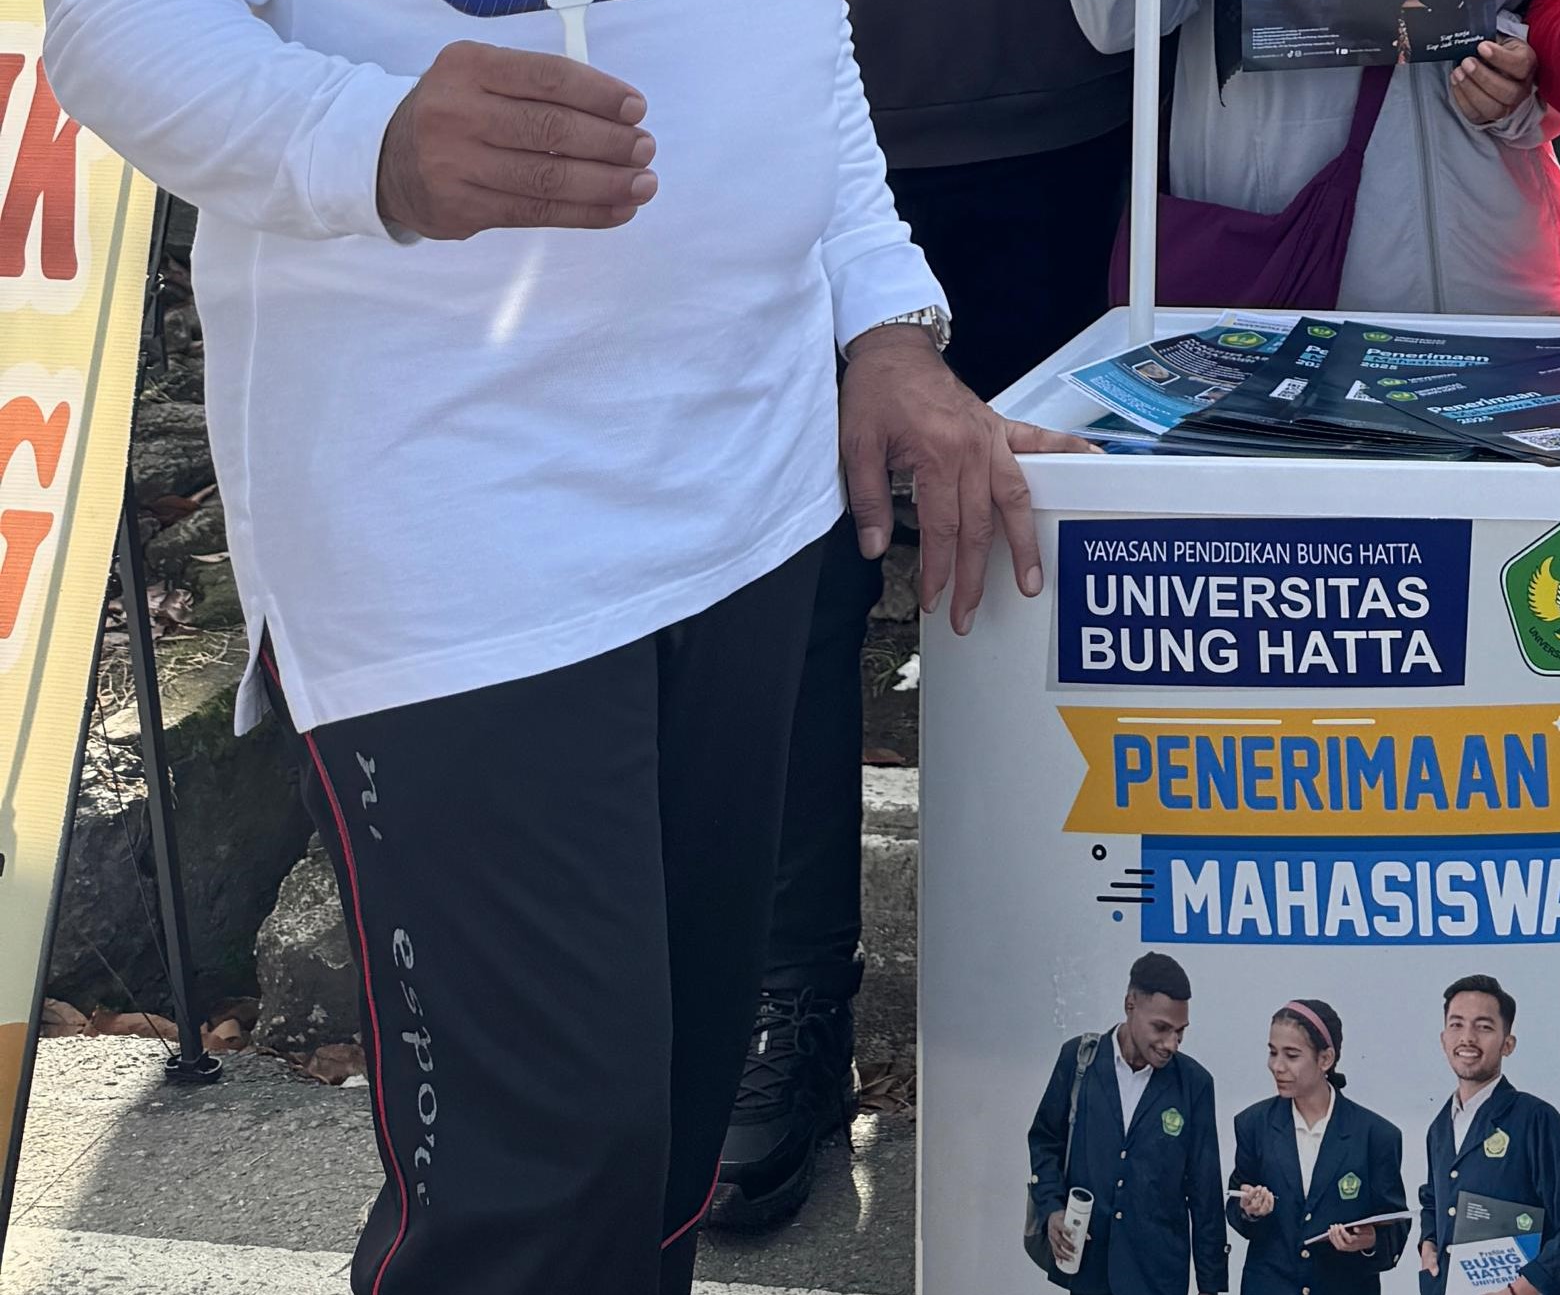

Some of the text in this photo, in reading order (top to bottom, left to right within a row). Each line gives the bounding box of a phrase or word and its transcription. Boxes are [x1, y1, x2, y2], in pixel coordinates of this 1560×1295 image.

[1366, 348, 1489, 362] Penerimaan
[1426, 391, 1542, 414] Penerimaan
[1084, 541, 1422, 564] YAYASAN PENDIDIKAN BUNG HATTA
[1086, 574, 1430, 619] UNIVERSITAS
[1081, 627, 1442, 674] BUNG HATTA
[1113, 733, 1550, 811] PENERIMAAN
[1460, 1253, 1521, 1271] BUNG
[1467, 1265, 1521, 1281] HATTA
